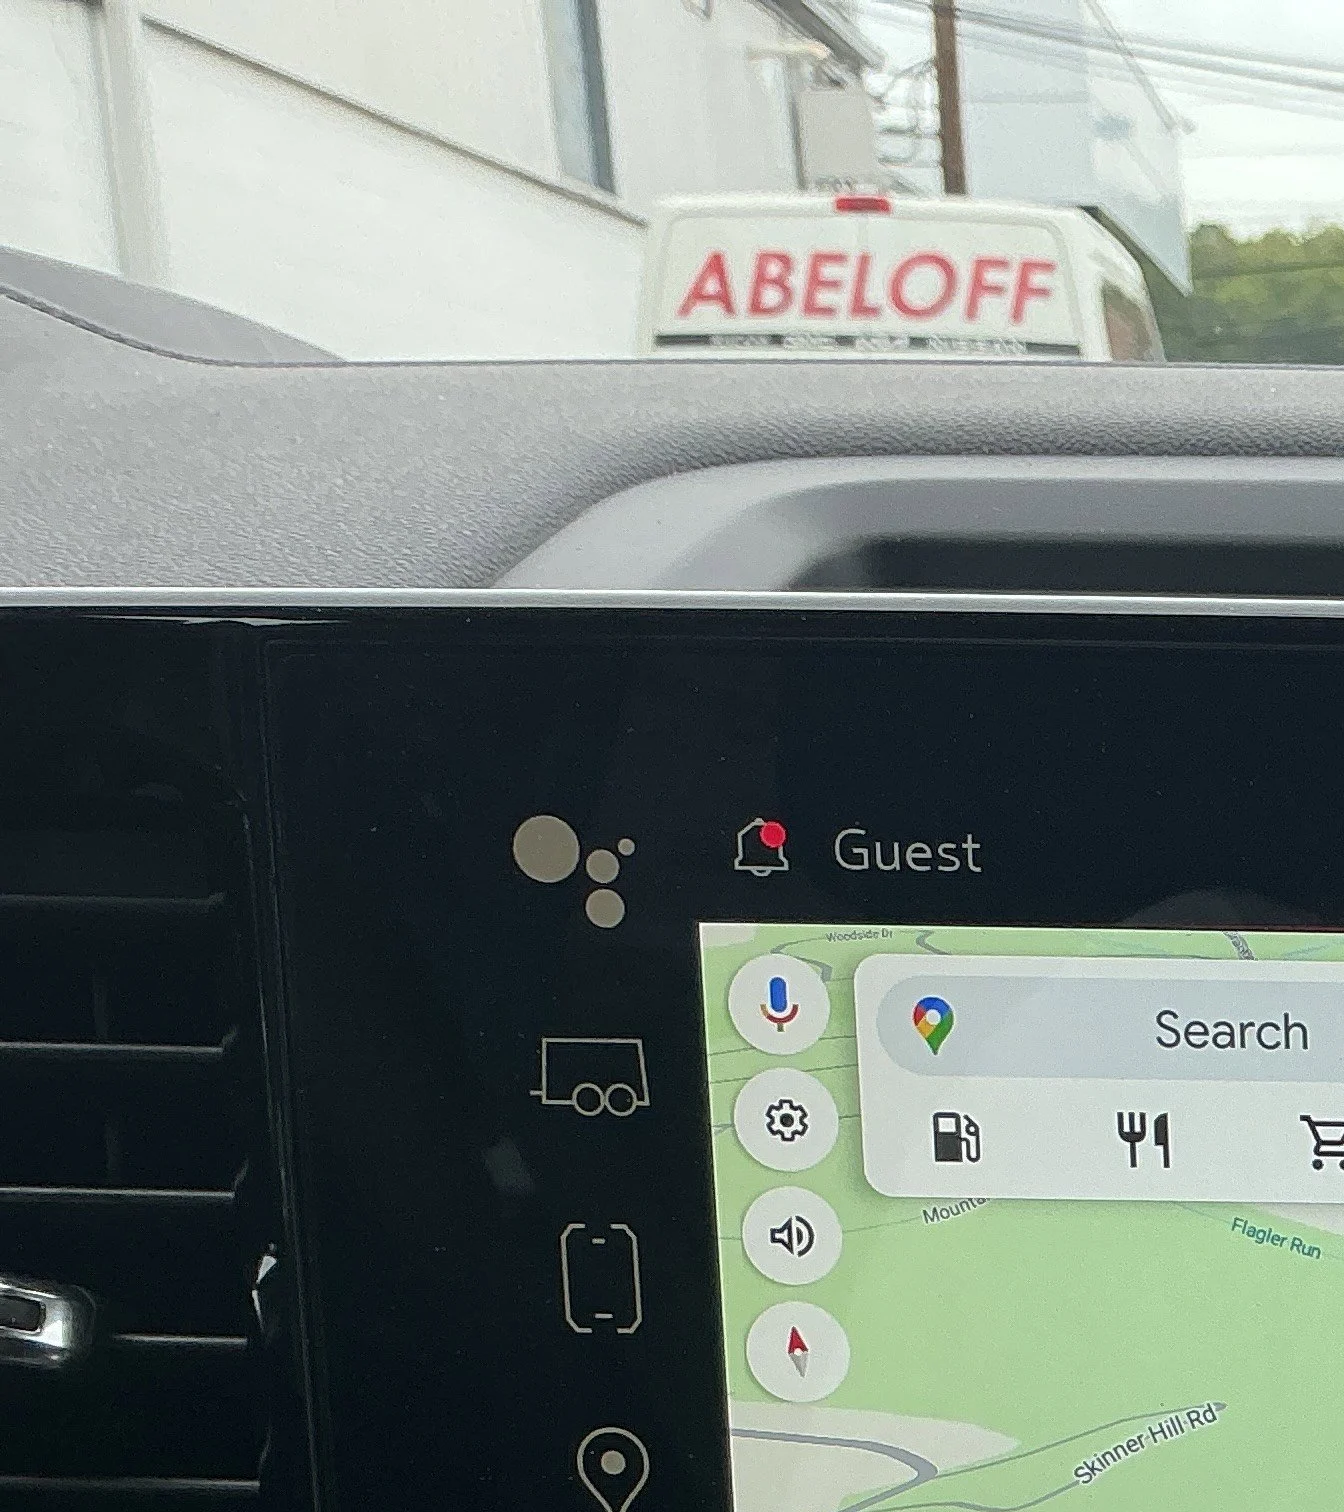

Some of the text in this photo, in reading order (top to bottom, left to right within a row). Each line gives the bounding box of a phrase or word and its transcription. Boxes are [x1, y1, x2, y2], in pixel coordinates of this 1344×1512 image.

[676, 249, 1057, 325] ABELOFF
[834, 828, 982, 872] Guest
[826, 930, 879, 942] Woodside
[1155, 1010, 1309, 1051] Search
[1230, 1216, 1322, 1260] Flagler Run
[1073, 1403, 1218, 1485] Skinner Hill Rd
